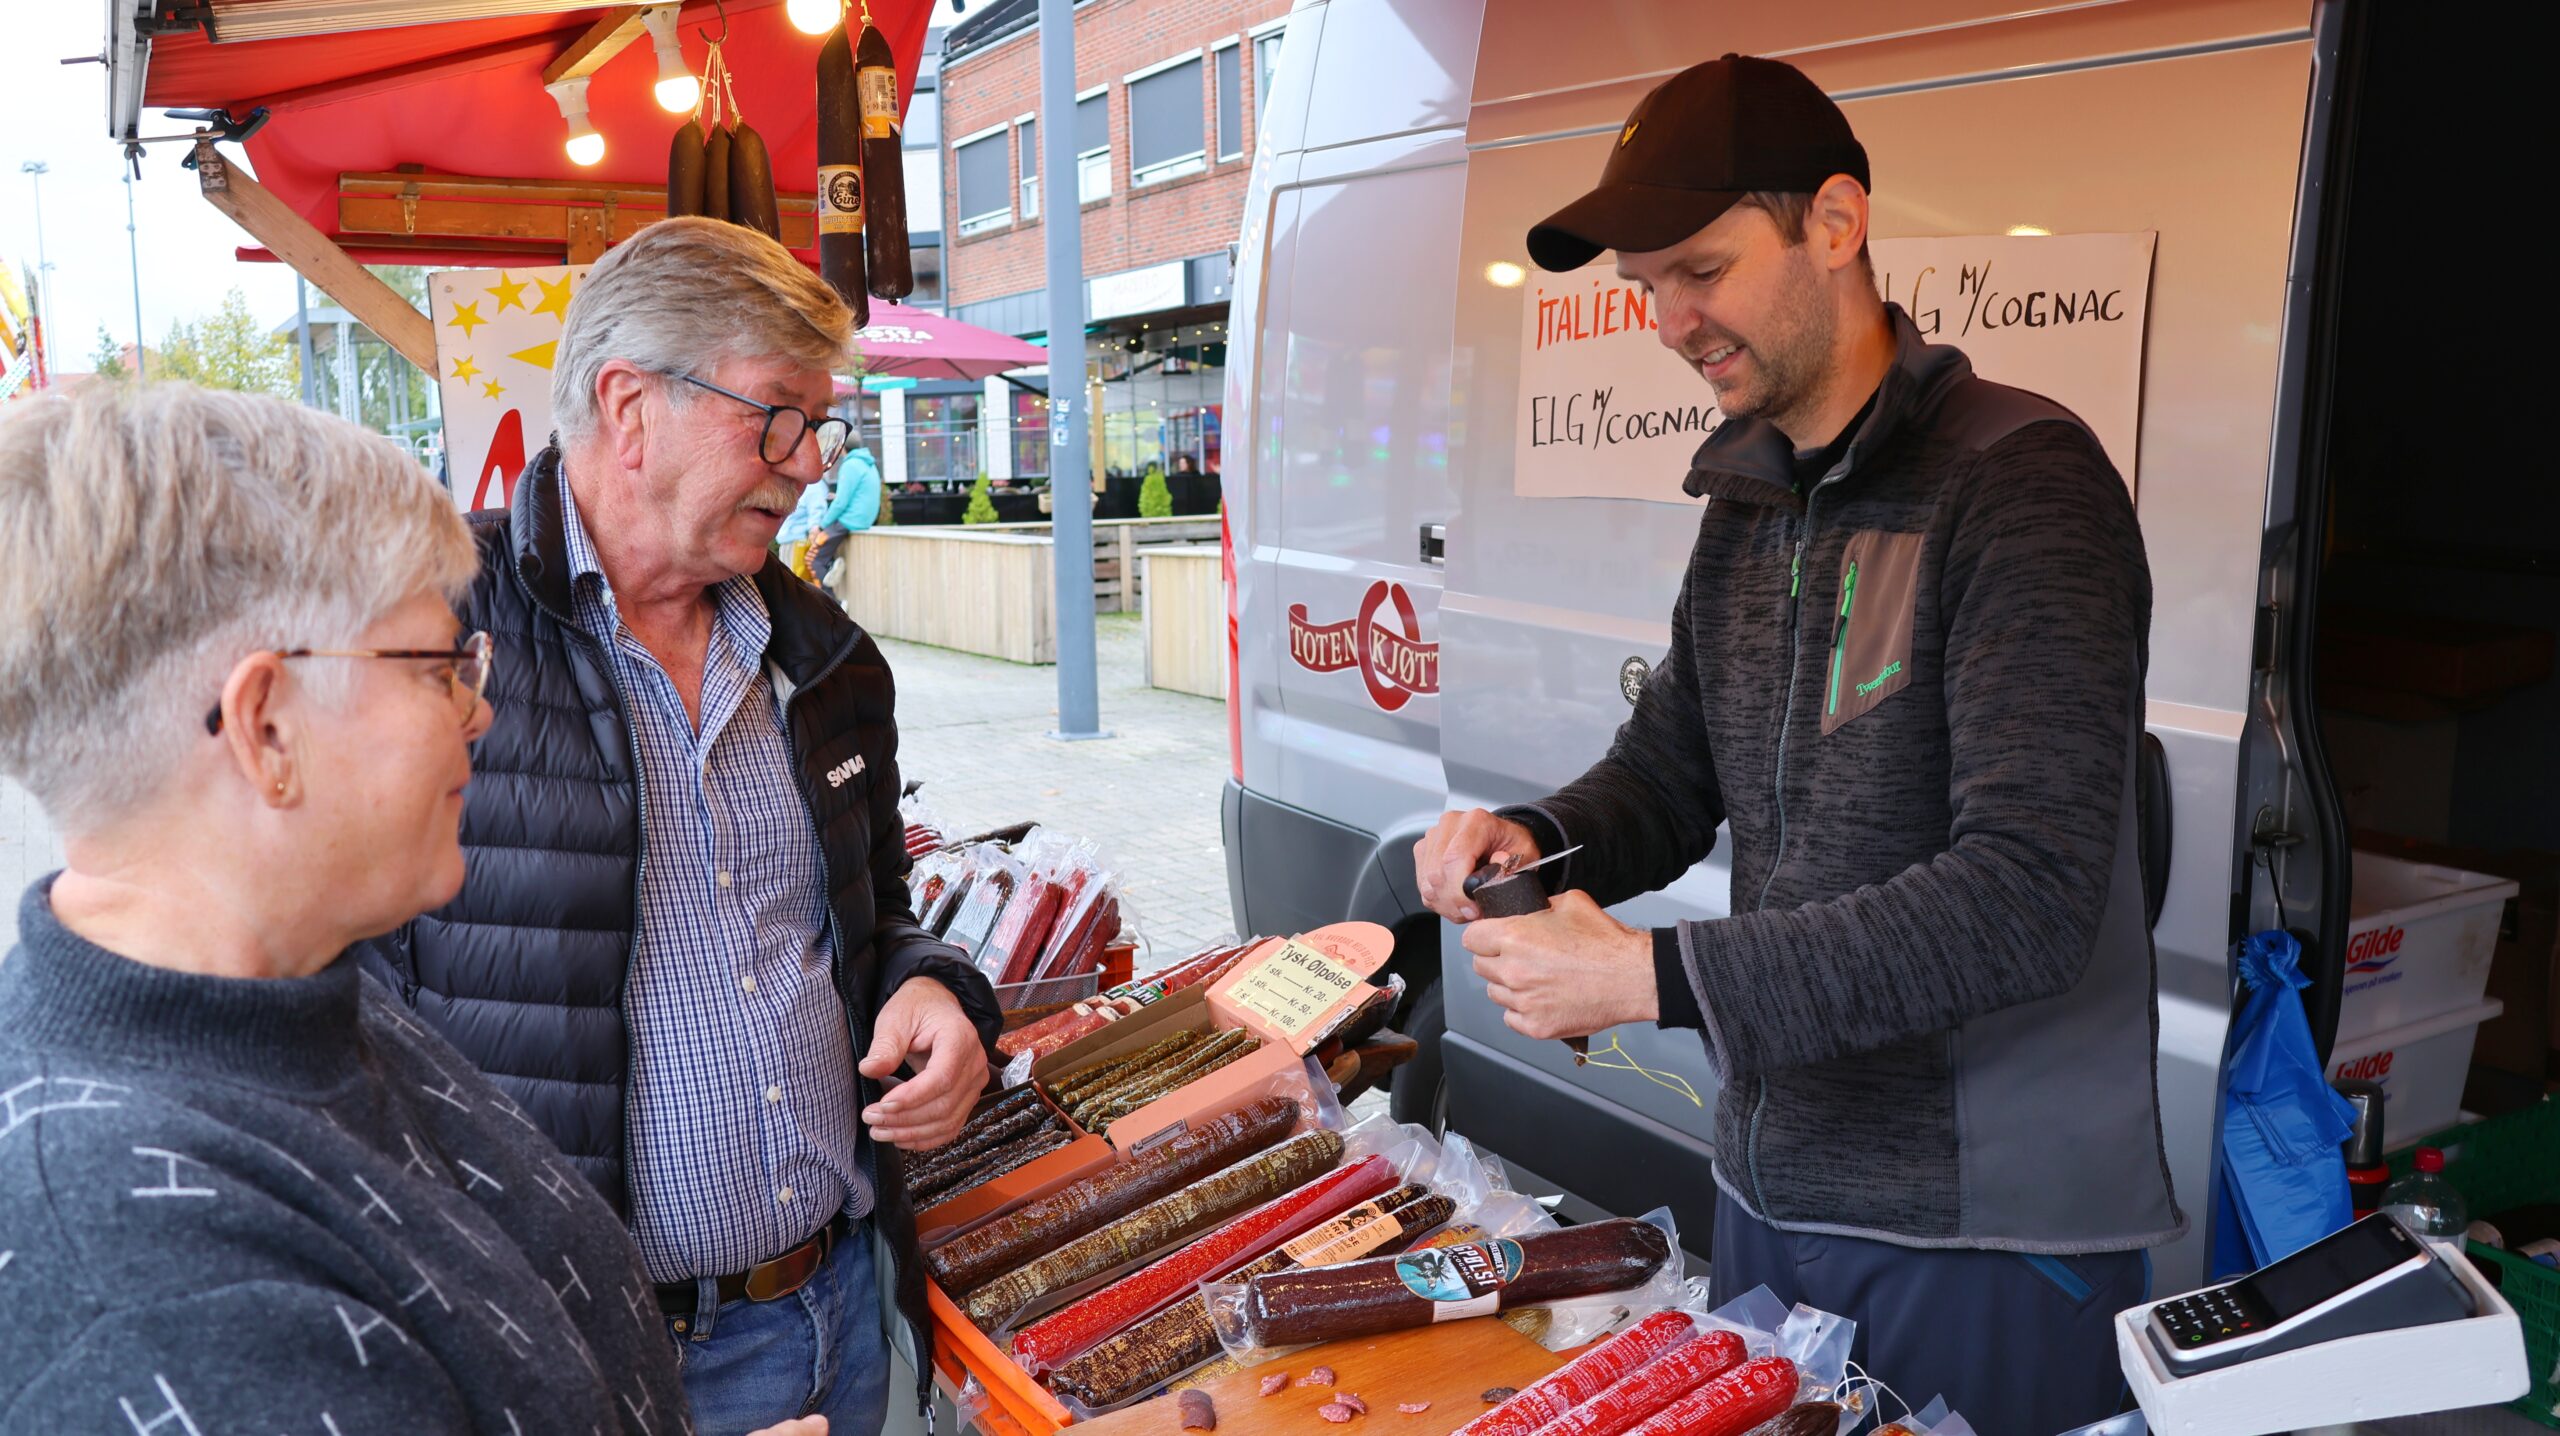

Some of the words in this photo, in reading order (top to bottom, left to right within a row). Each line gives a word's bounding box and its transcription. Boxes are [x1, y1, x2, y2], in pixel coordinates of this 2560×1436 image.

[1532, 393, 1584, 448] ELG
[1291, 621, 1358, 667] TOTEN
[1280, 943, 1307, 967] Tysk
[1306, 958, 1352, 990] Ølpølse
[2346, 924, 2404, 965] Gilde
[1452, 1255, 1474, 1281] COGNAC
